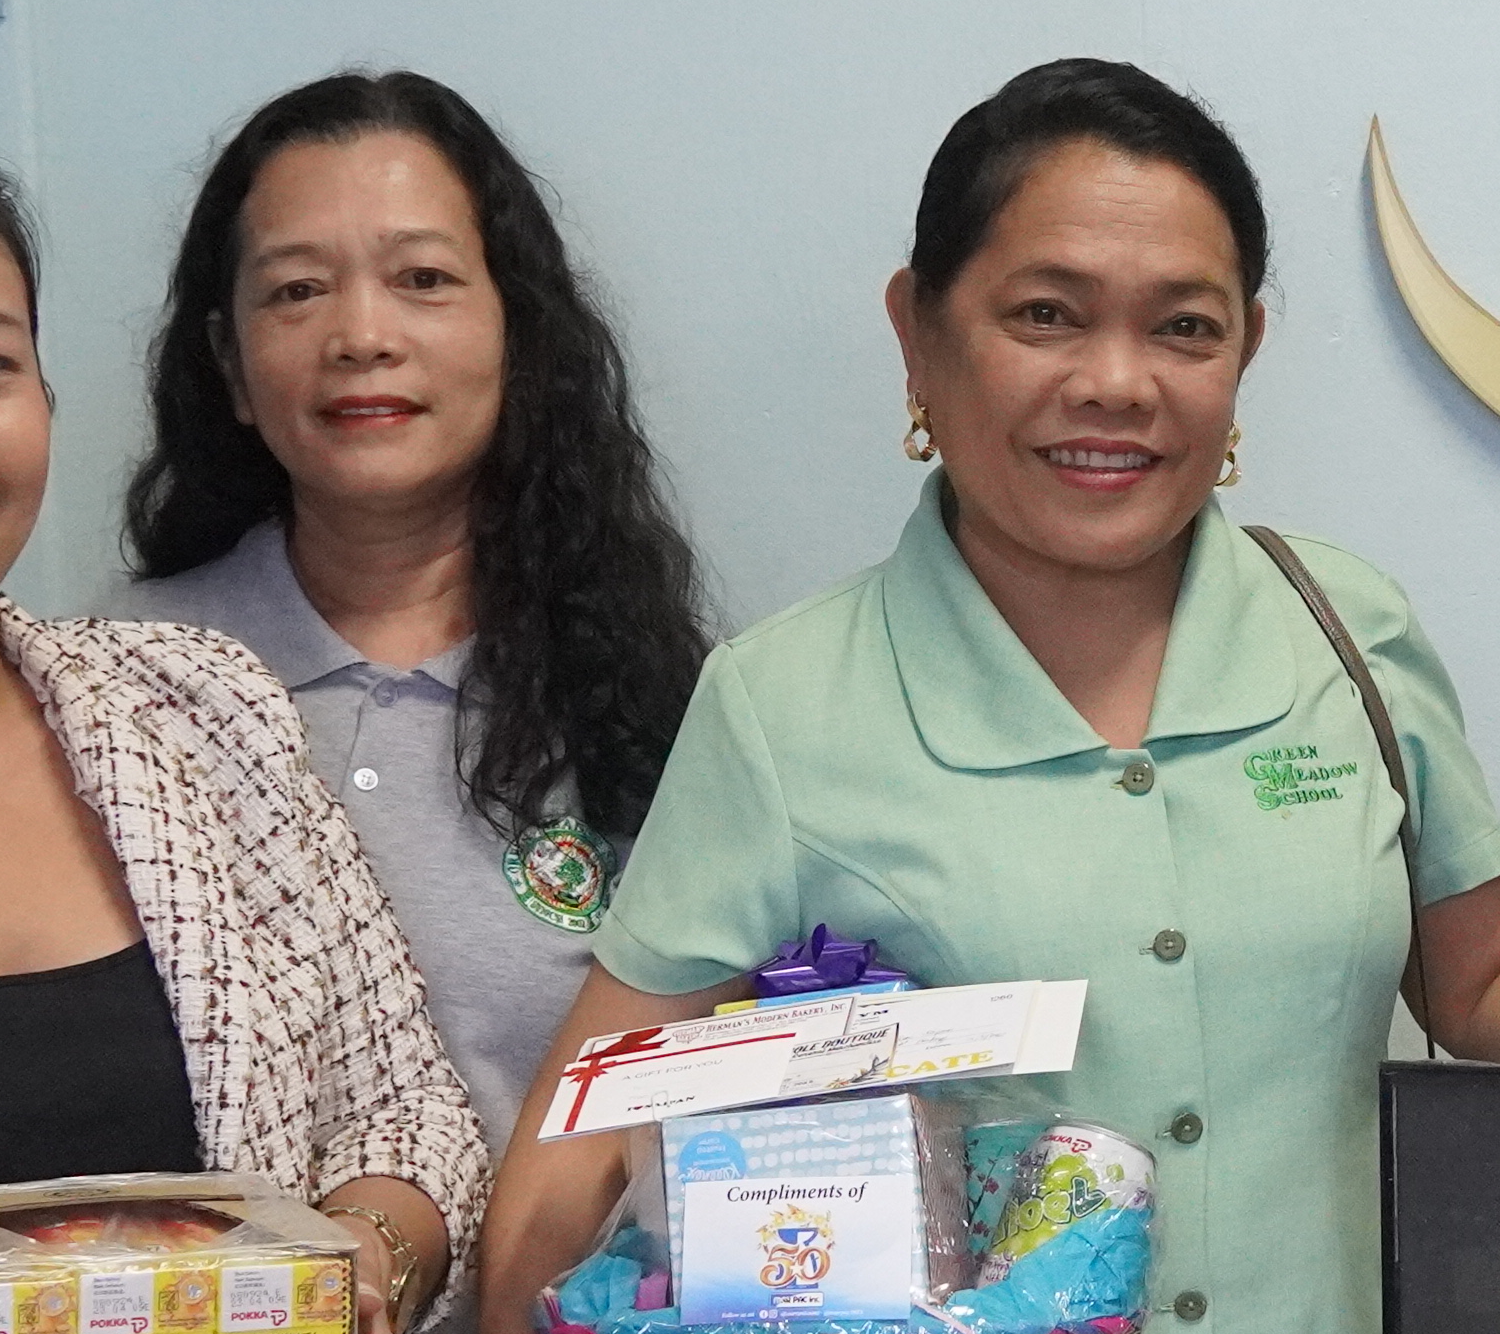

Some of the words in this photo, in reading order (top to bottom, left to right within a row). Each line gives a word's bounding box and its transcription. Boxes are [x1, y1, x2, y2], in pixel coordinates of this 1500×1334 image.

[634, 1068, 662, 1079] GIFT
[665, 1063, 693, 1074] FOR
[885, 1049, 994, 1078] CATE
[726, 1183, 843, 1205] Compliments
[847, 1181, 869, 1203] of
[90, 1318, 128, 1329] POKKA
[231, 1310, 269, 1321] POKKA
